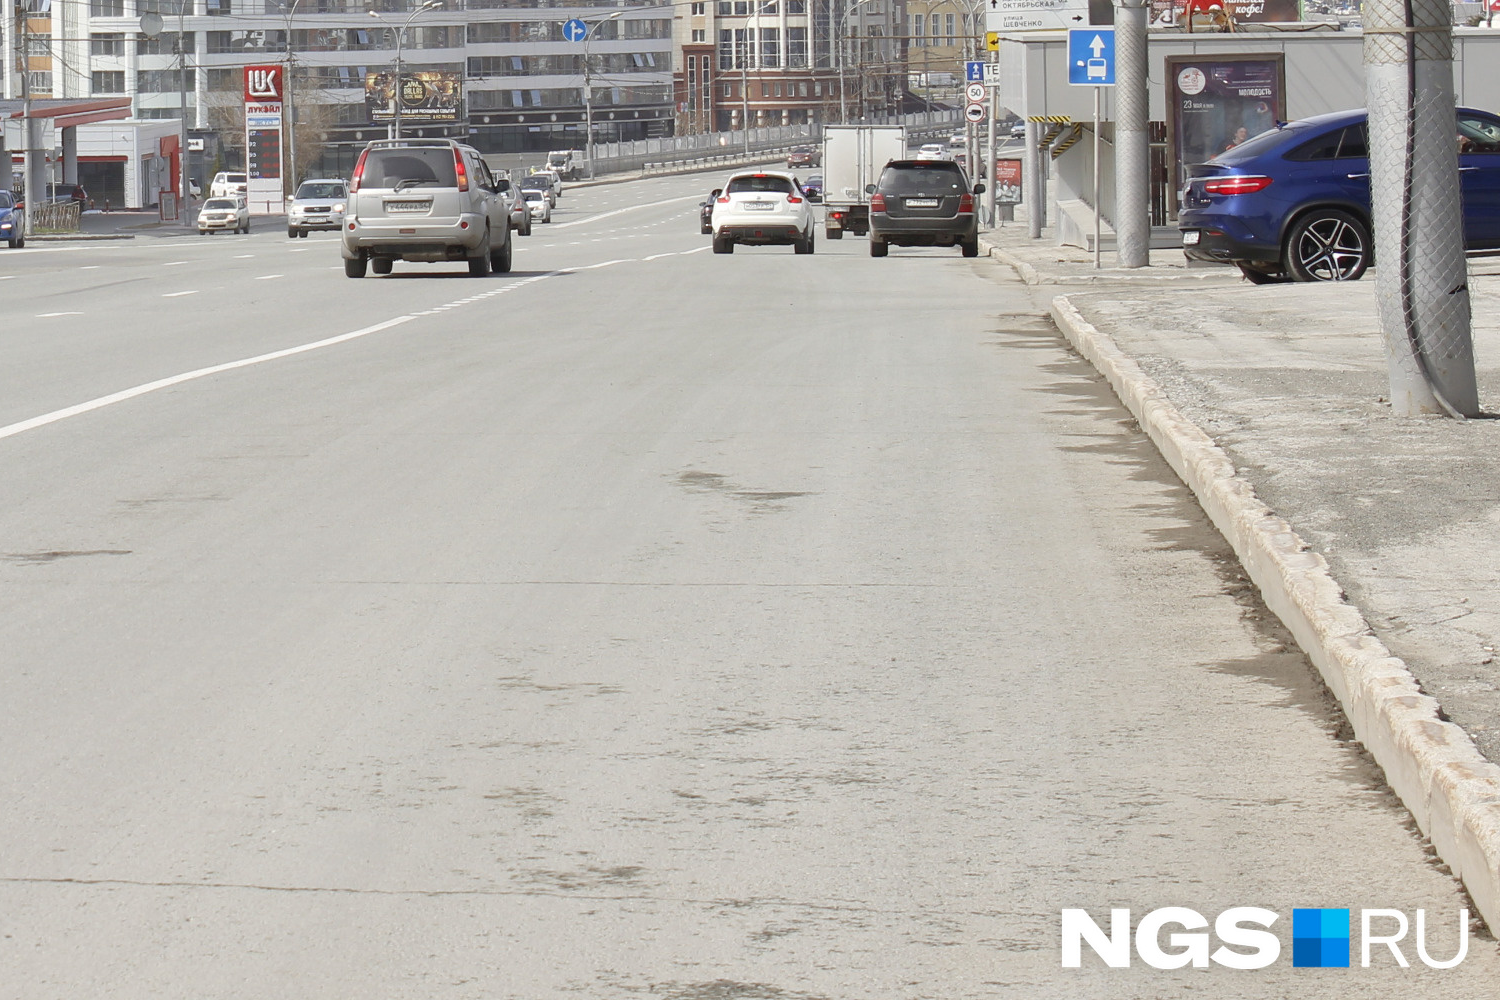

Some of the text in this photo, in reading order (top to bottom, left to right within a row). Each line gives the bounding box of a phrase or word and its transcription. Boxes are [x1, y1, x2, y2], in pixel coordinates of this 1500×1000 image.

[1002, 1, 1055, 9] ОКТЯБРЬСКАЯ
[1235, 3, 1264, 18] кофе!
[1183, 100, 1192, 109] 23
